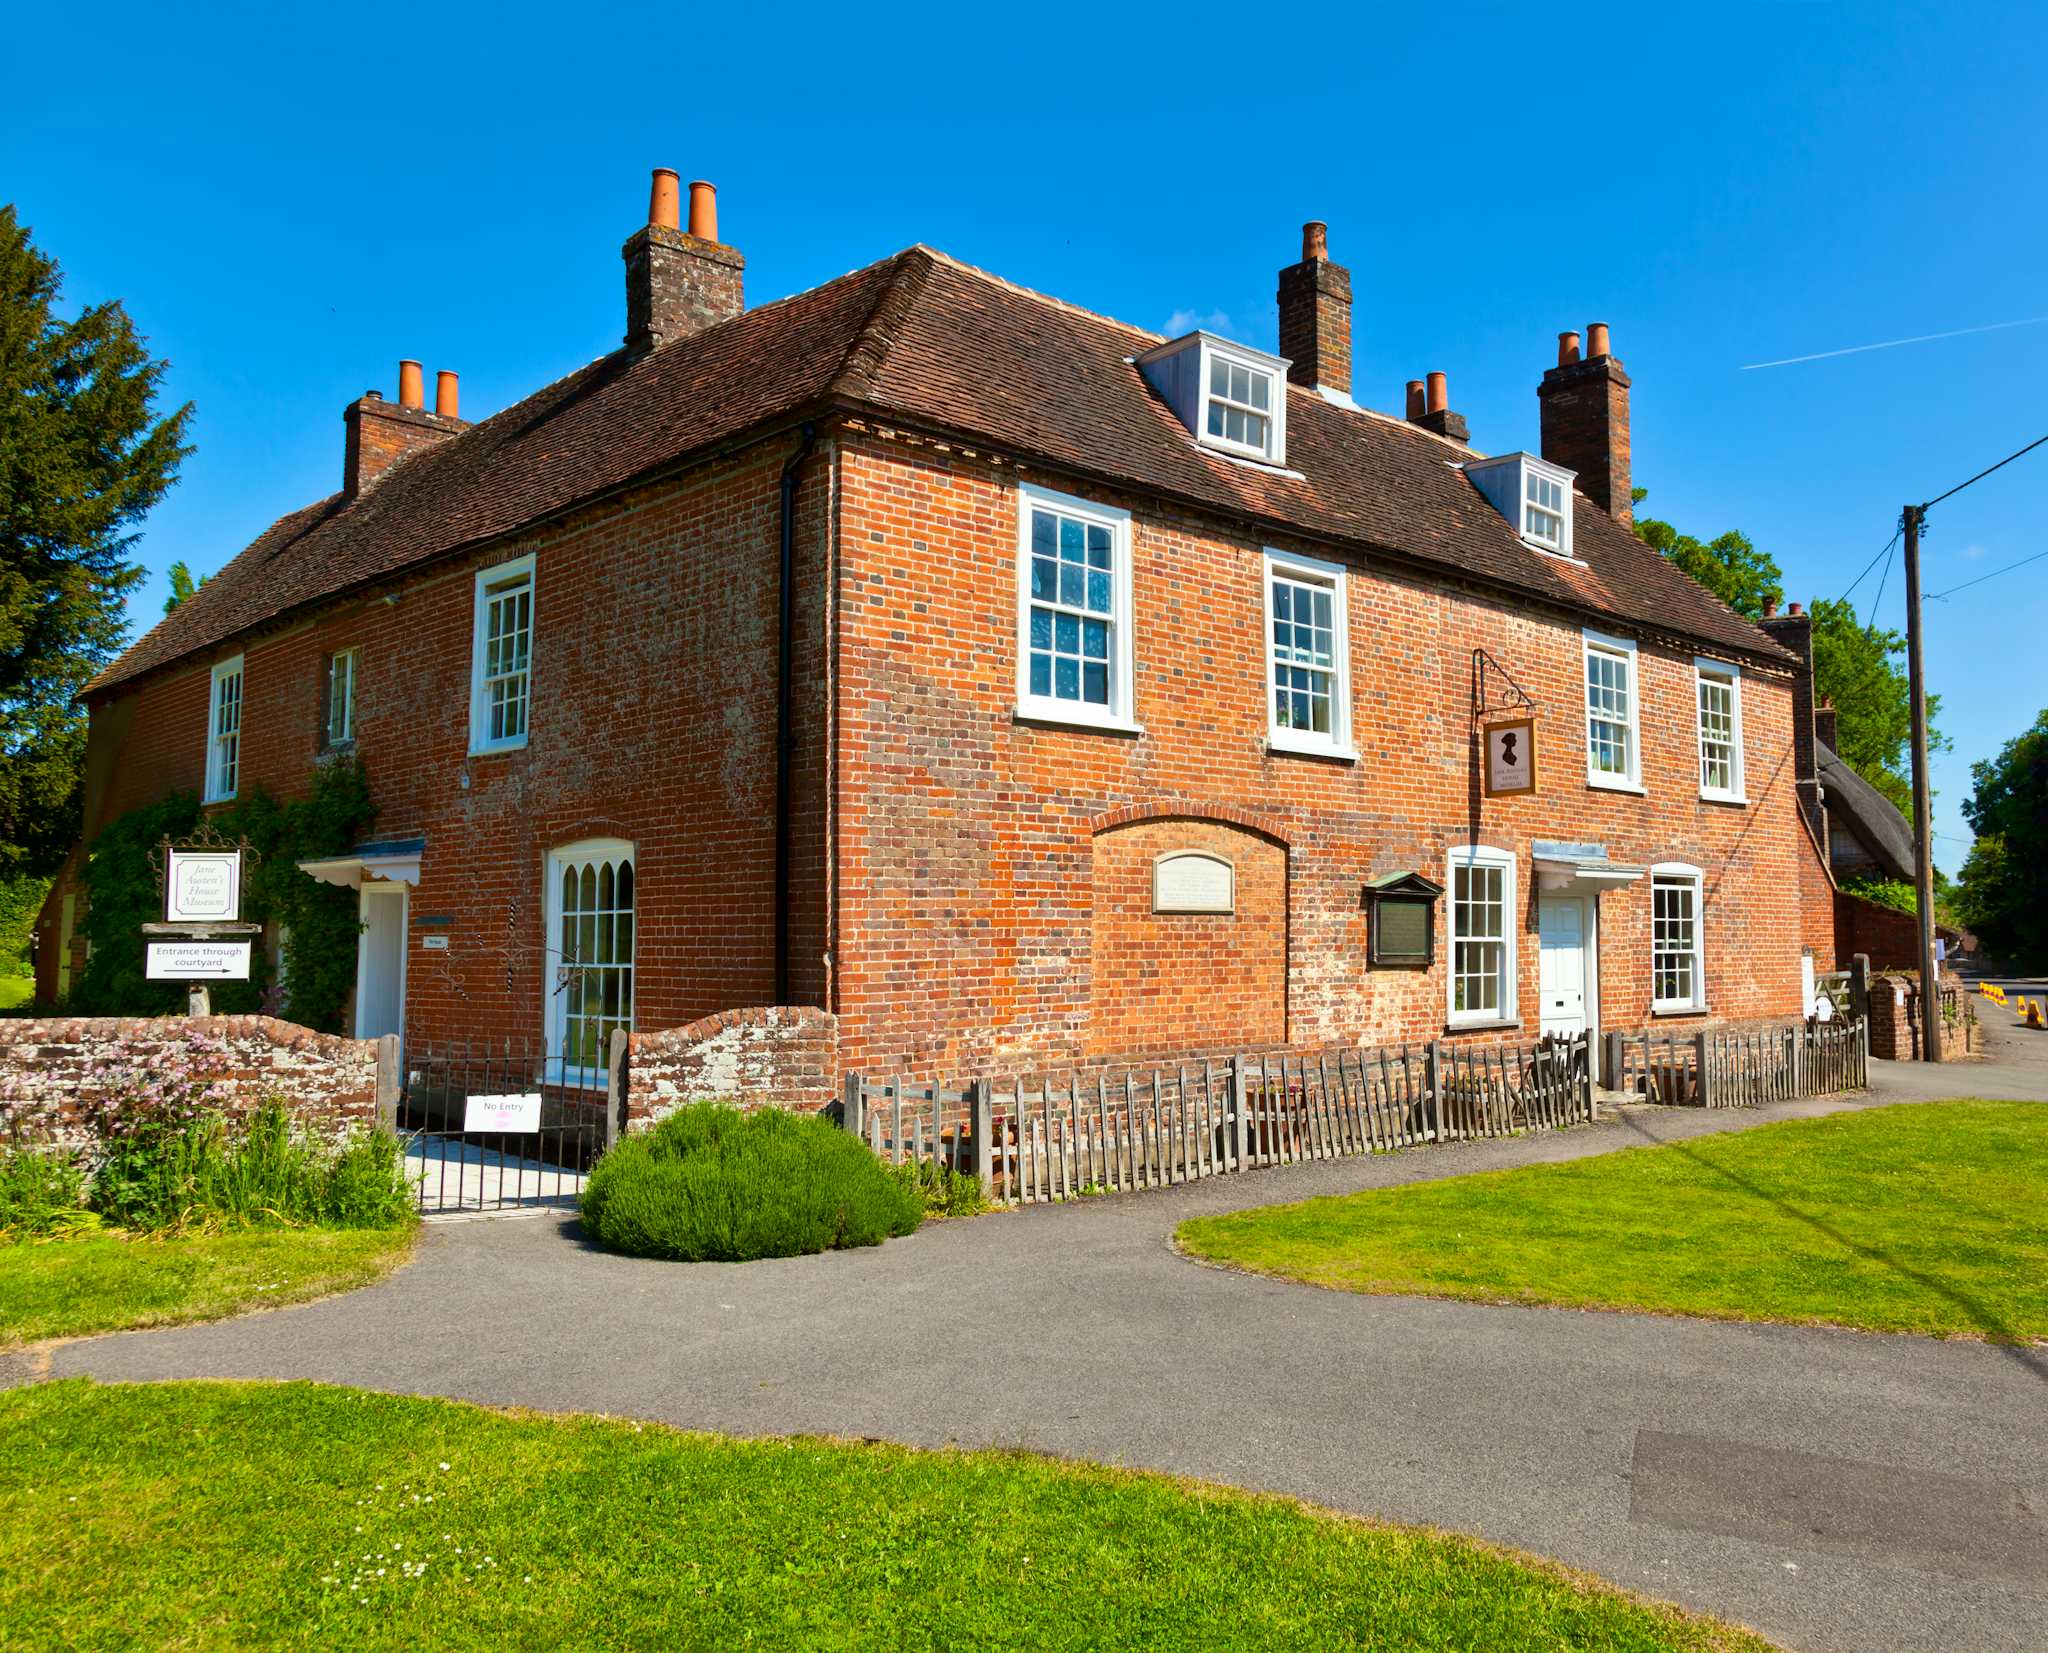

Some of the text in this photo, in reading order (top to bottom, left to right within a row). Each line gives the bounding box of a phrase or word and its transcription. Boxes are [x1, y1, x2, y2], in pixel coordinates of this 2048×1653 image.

[188, 886, 219, 895] House
[156, 947, 242, 958] Entrance through
[175, 957, 222, 968] courtyard
[484, 1102, 523, 1112] No Entry
